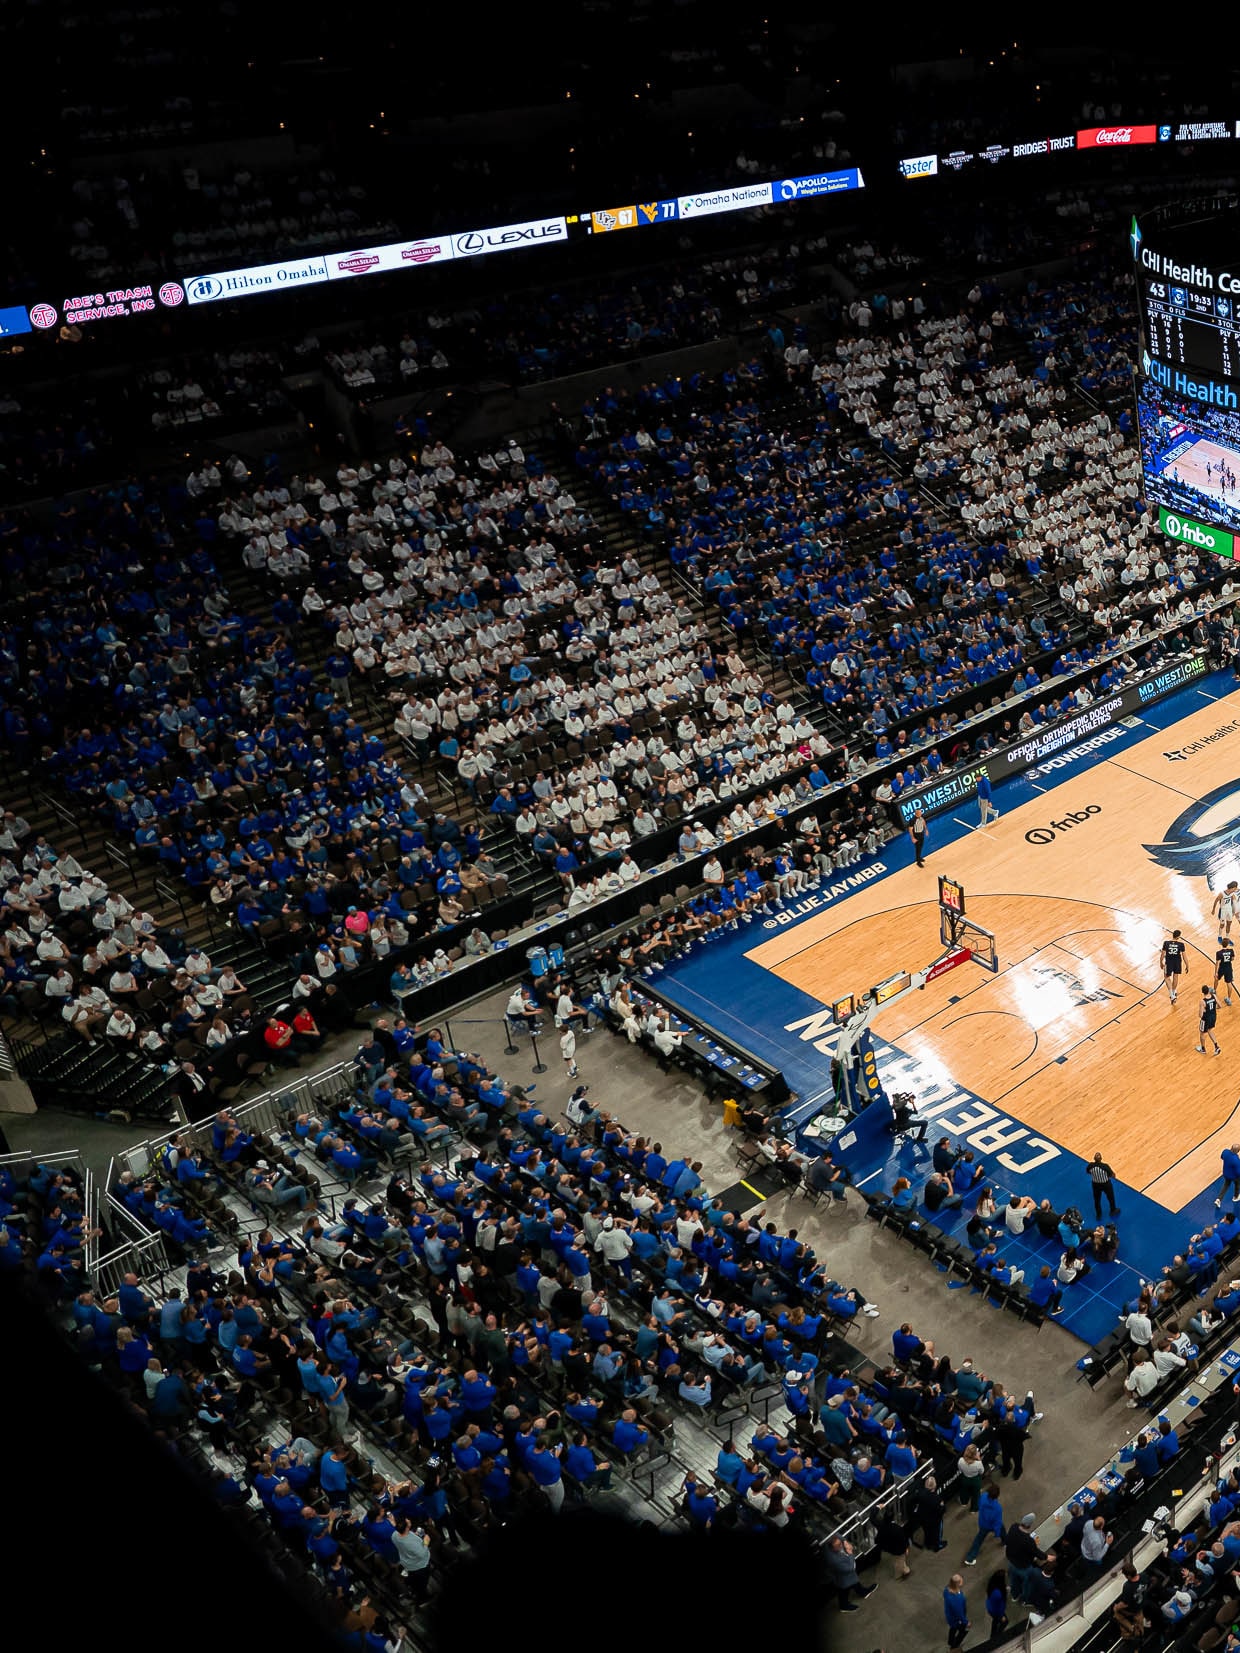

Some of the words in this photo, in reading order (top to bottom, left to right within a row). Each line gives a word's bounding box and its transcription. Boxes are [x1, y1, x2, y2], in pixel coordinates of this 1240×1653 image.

[1013, 141, 1048, 157] BRIDGES
[1050, 136, 1075, 151] TRUST
[796, 177, 828, 189] APOLLO
[696, 194, 730, 208] Omaha
[732, 187, 769, 200] National
[488, 224, 562, 246] LEXUS
[226, 276, 272, 291] Hilton
[276, 264, 326, 282] Omaha
[1142, 248, 1160, 273] CHI
[1163, 257, 1214, 289] Health
[63, 296, 104, 311] ABE'S
[107, 286, 152, 303] TRASH
[1150, 282, 1165, 297] 43
[1189, 293, 1212, 306] 19:33
[67, 306, 130, 324] SERVICE,
[133, 299, 156, 312] INC
[1147, 310, 1158, 318] PLY
[1153, 302, 1165, 311] TOL
[1175, 308, 1186, 316] FLS
[1220, 329, 1231, 338] PLY
[1223, 320, 1234, 330] TOL
[1150, 359, 1171, 387] CHI
[1175, 374, 1237, 408] Health
[1181, 523, 1216, 548] fnbo
[1138, 683, 1154, 698] MD
[1155, 669, 1181, 689] WEST
[1184, 657, 1205, 674] ONE
[1008, 740, 1042, 762] OFFICIAL
[1043, 715, 1089, 745] ORTHOPEDIC
[1090, 697, 1123, 719] DOCTORS
[1026, 751, 1036, 763] OF
[1037, 731, 1076, 758] CREIGHTON
[1077, 712, 1111, 736] ATHLETICS
[1183, 741, 1202, 755] CHI
[1200, 724, 1238, 748] Health
[1038, 727, 1127, 775] POWERADE
[901, 798, 922, 816] MD
[926, 781, 958, 805] WEST
[1050, 804, 1102, 832] fnbo
[763, 861, 888, 929] @BLUEJAYMBB
